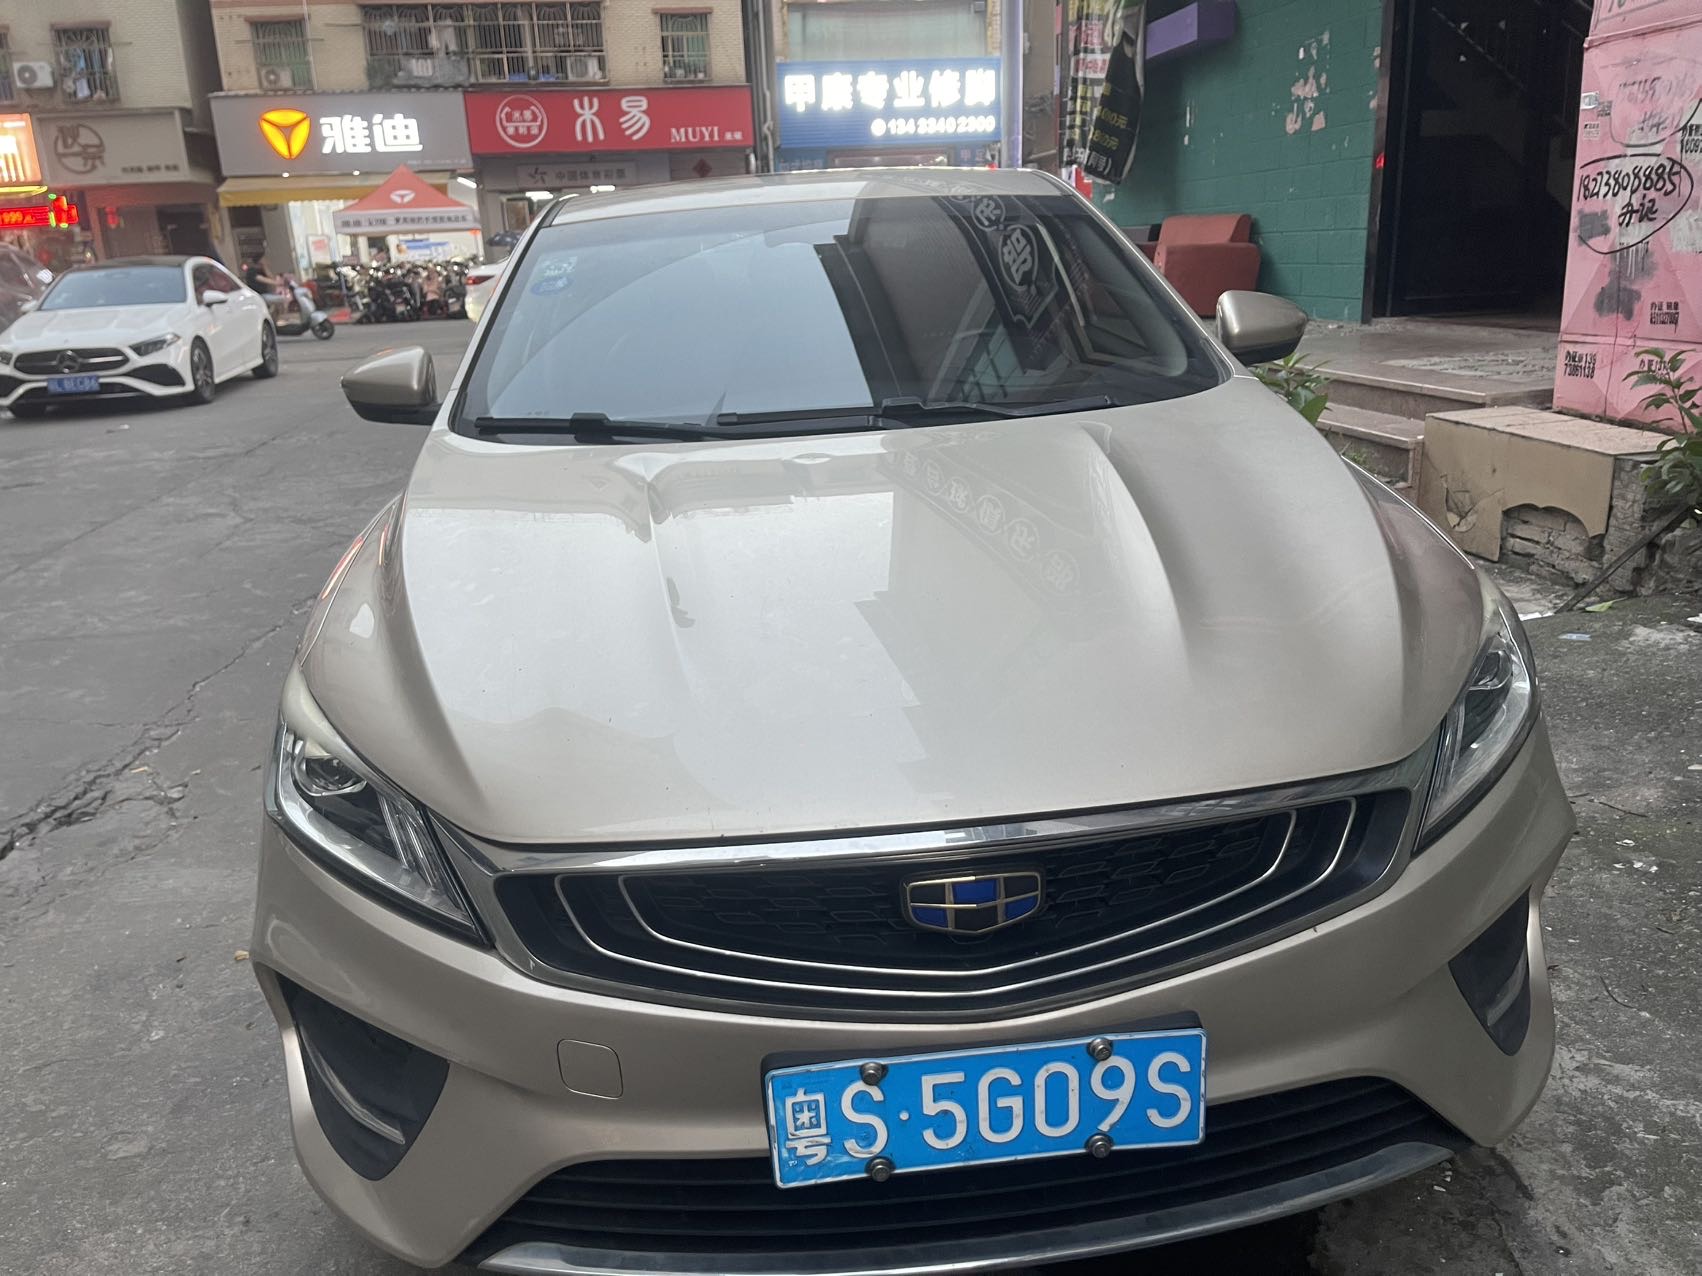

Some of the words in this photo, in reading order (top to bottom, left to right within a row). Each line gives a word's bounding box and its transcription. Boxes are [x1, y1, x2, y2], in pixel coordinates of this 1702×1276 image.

[319, 113, 424, 154] 雅迪
[671, 127, 719, 142] MUYI
[1577, 163, 1681, 201] 18273808885
